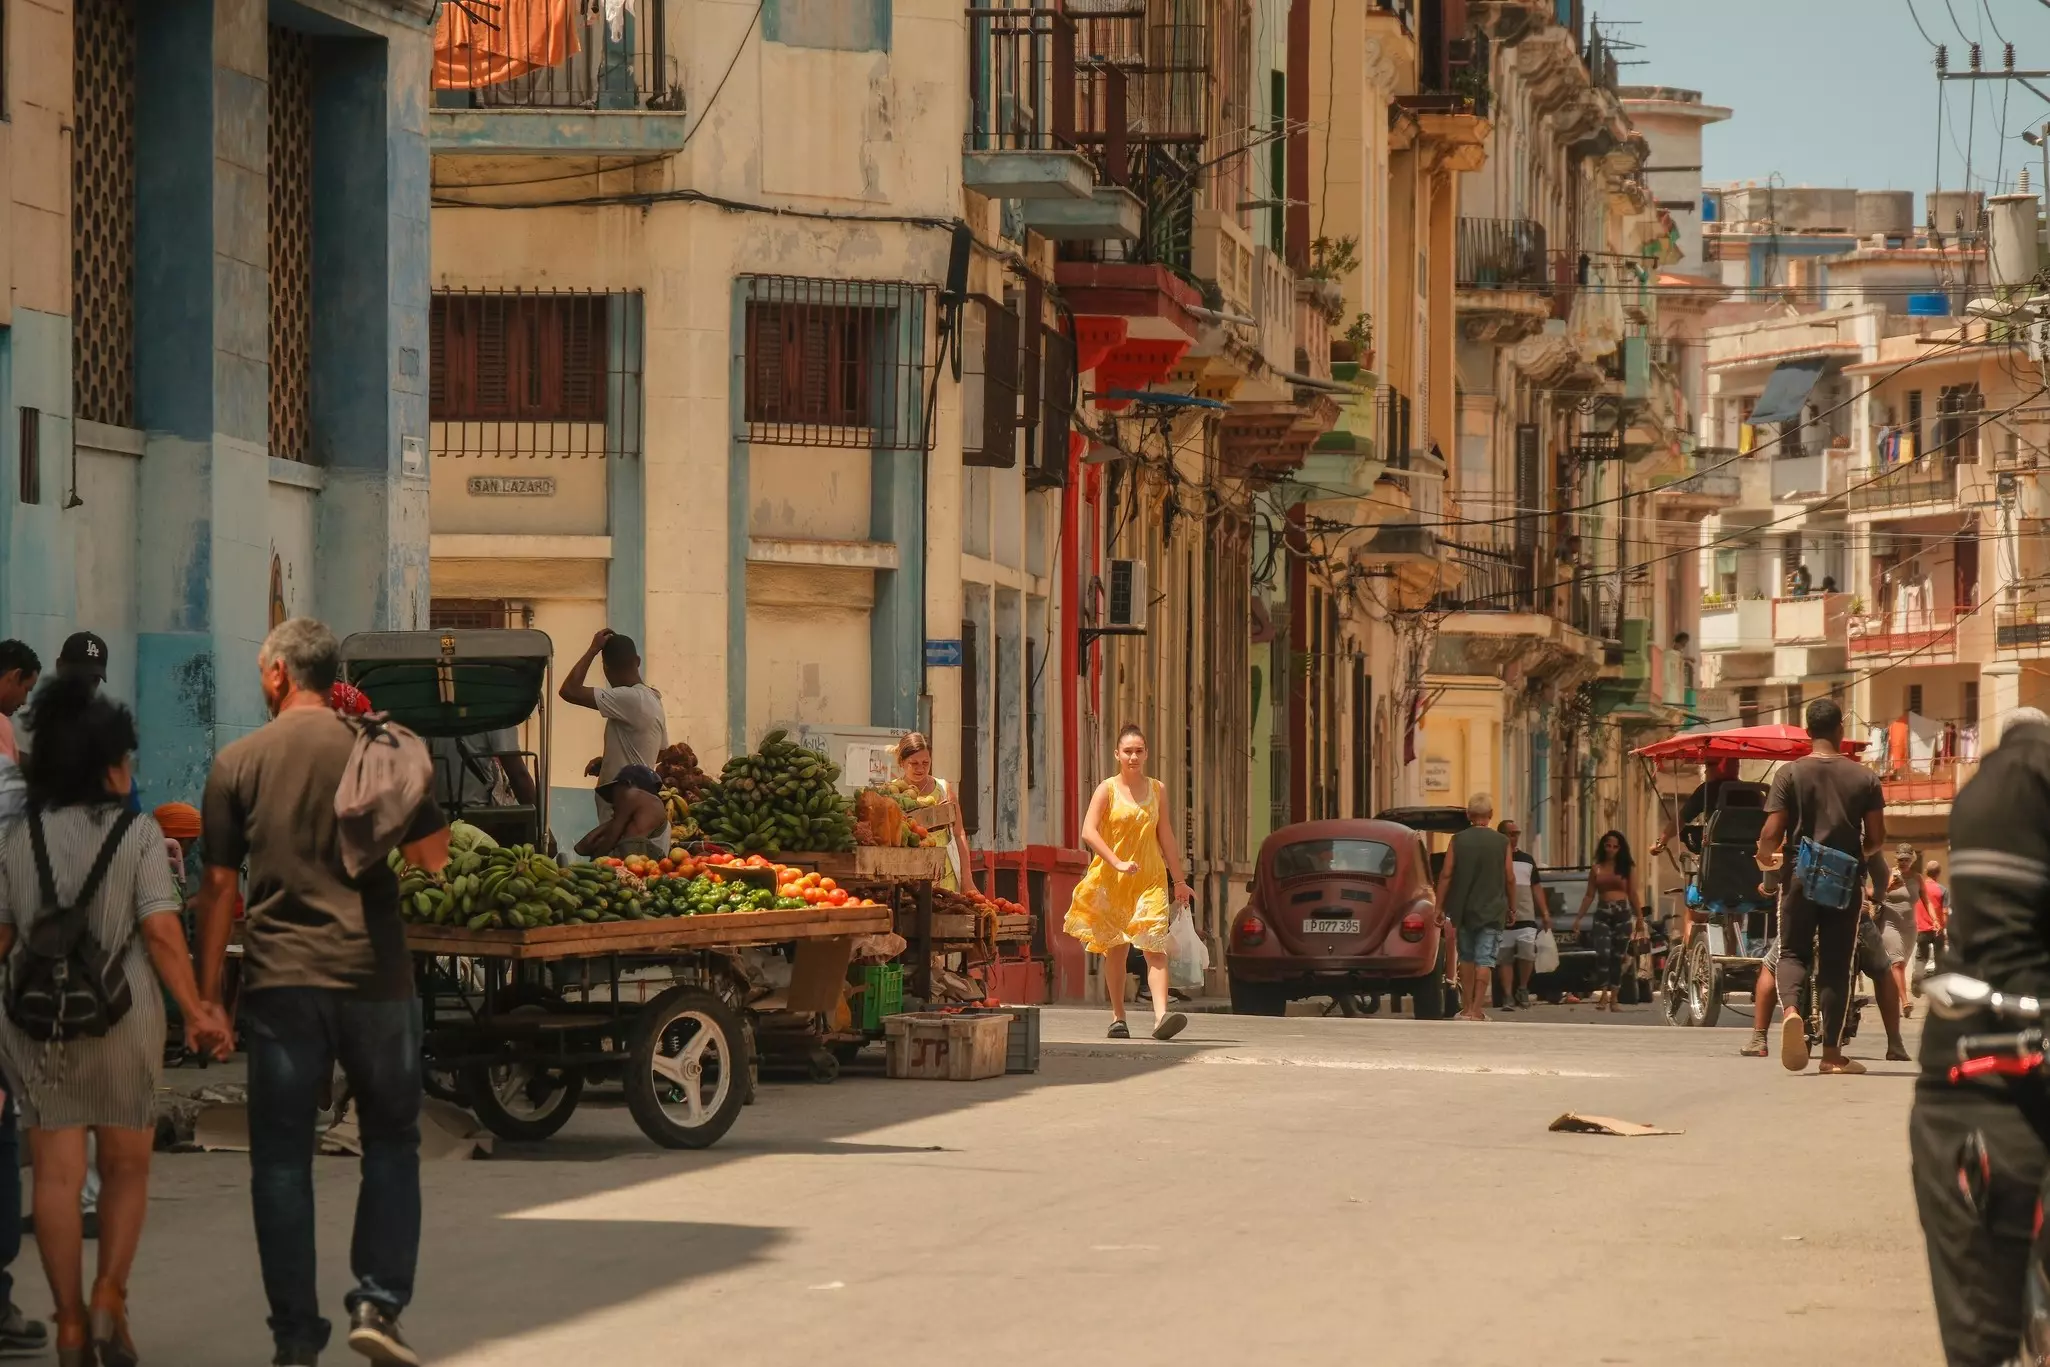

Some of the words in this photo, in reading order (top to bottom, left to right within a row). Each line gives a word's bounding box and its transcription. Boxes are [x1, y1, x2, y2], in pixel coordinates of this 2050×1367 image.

[474, 480, 498, 493] SAN
[502, 480, 550, 493] LAZARO
[86, 640, 100, 657] LA
